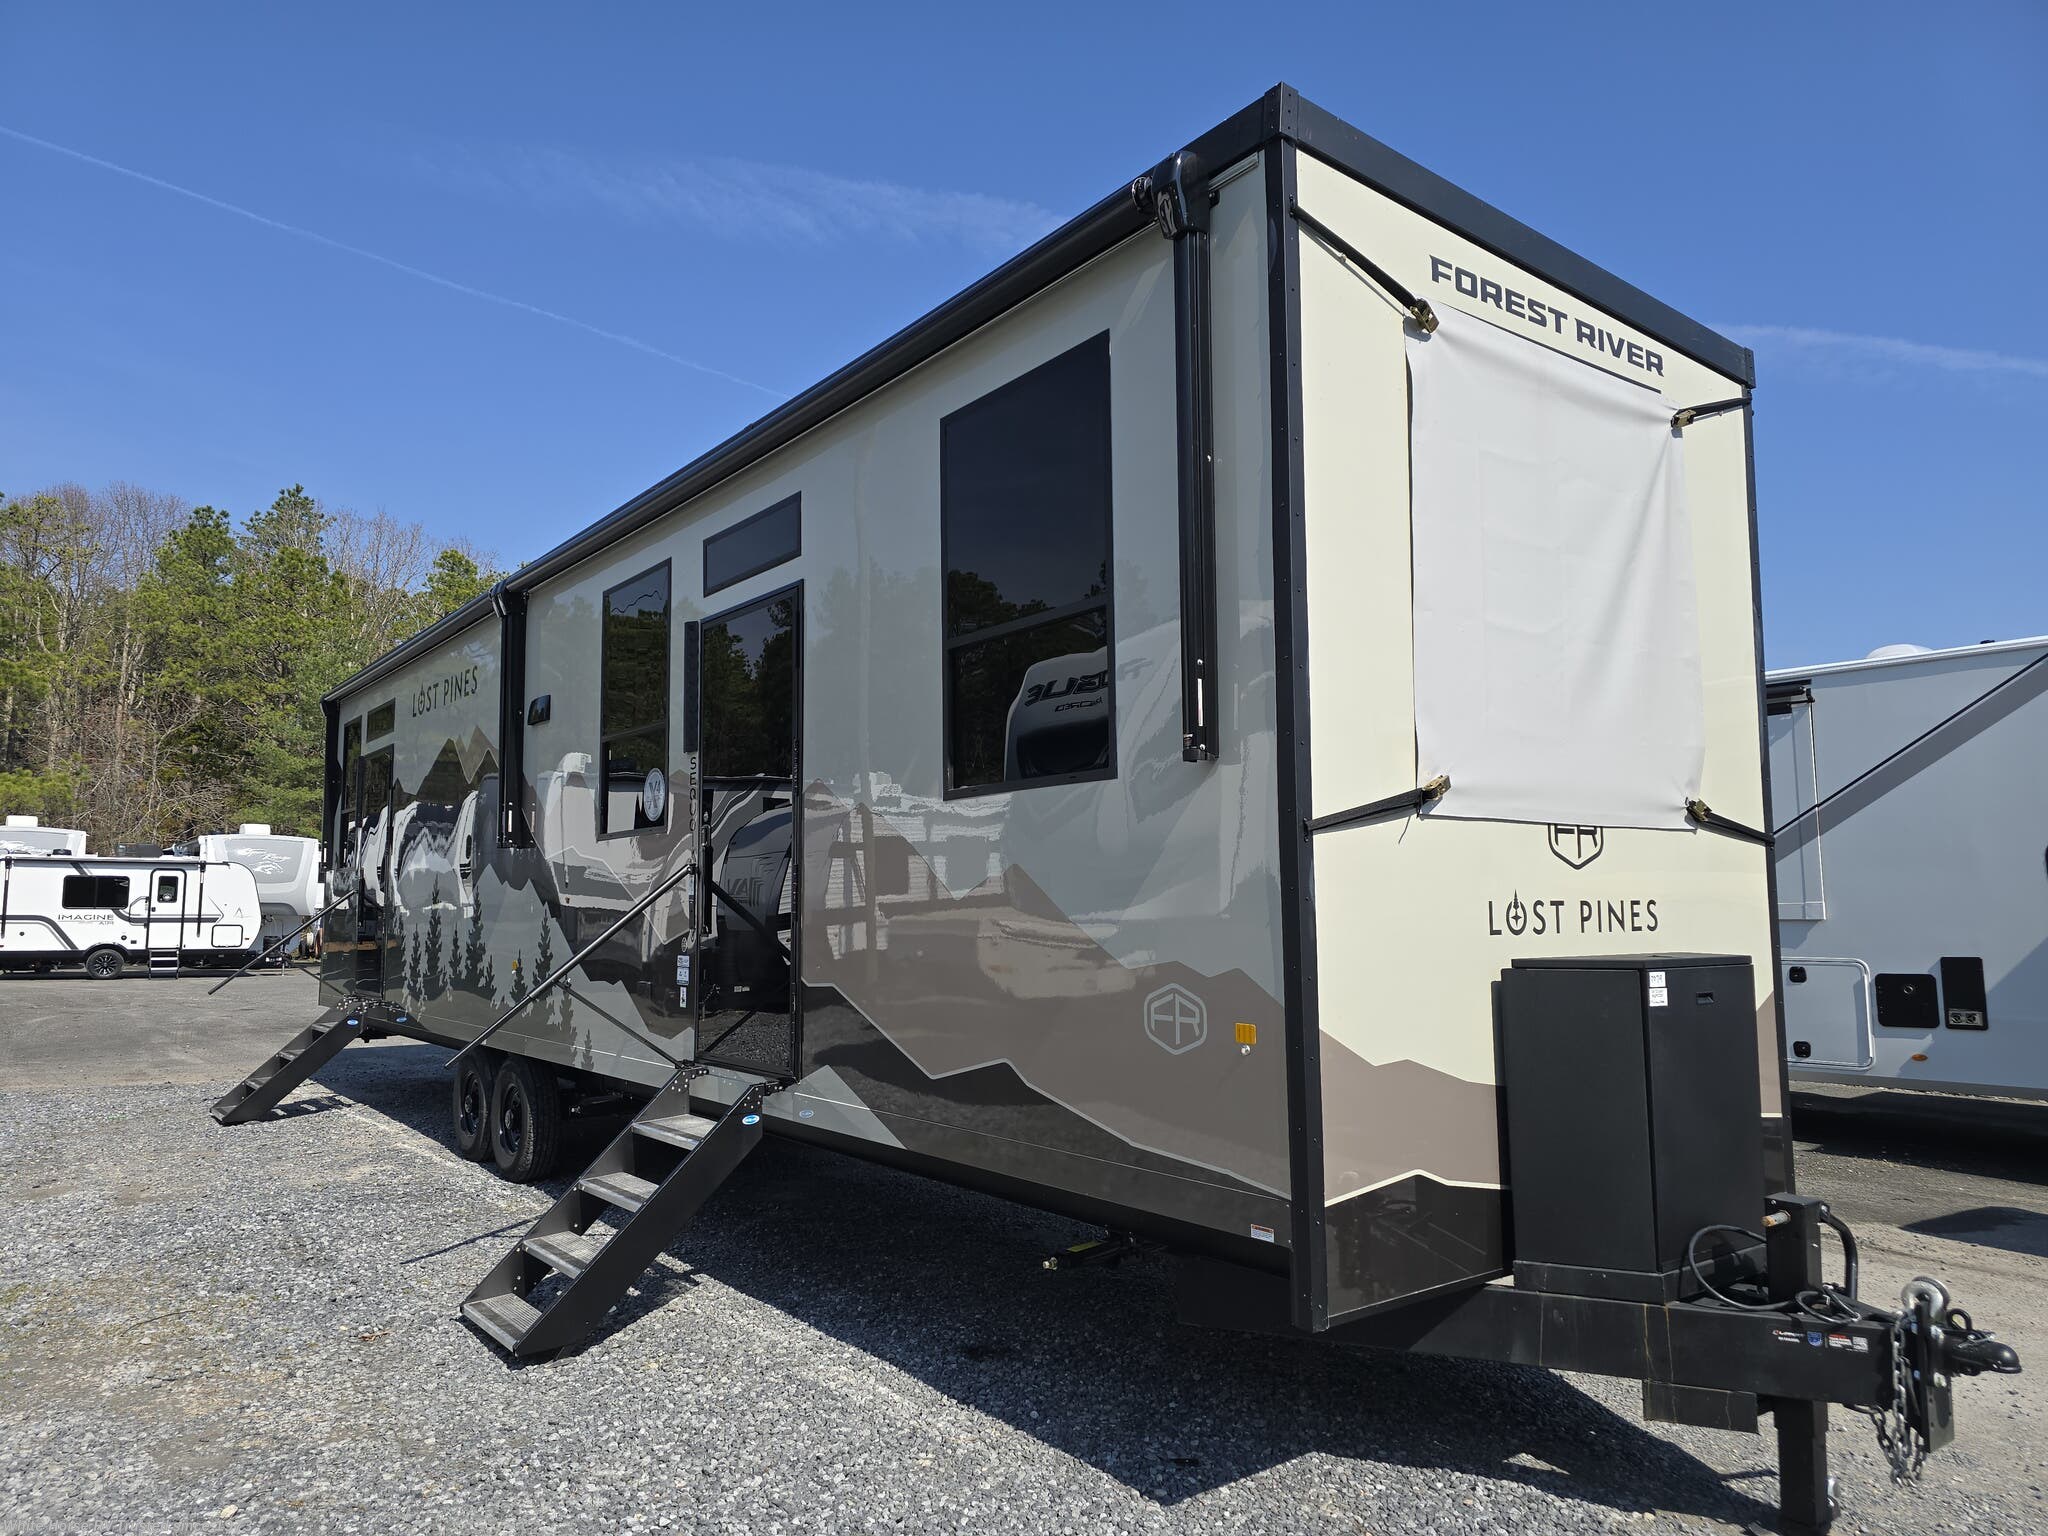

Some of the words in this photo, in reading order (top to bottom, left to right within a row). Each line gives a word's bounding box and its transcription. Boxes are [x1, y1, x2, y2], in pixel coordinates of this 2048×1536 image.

[1429, 254, 1568, 335] FOREST
[1574, 317, 1665, 378] RIVER
[412, 682, 440, 718] LOST
[443, 665, 478, 706] PINES
[1488, 889, 1565, 936] LOST
[1580, 899, 1659, 935] PINES
